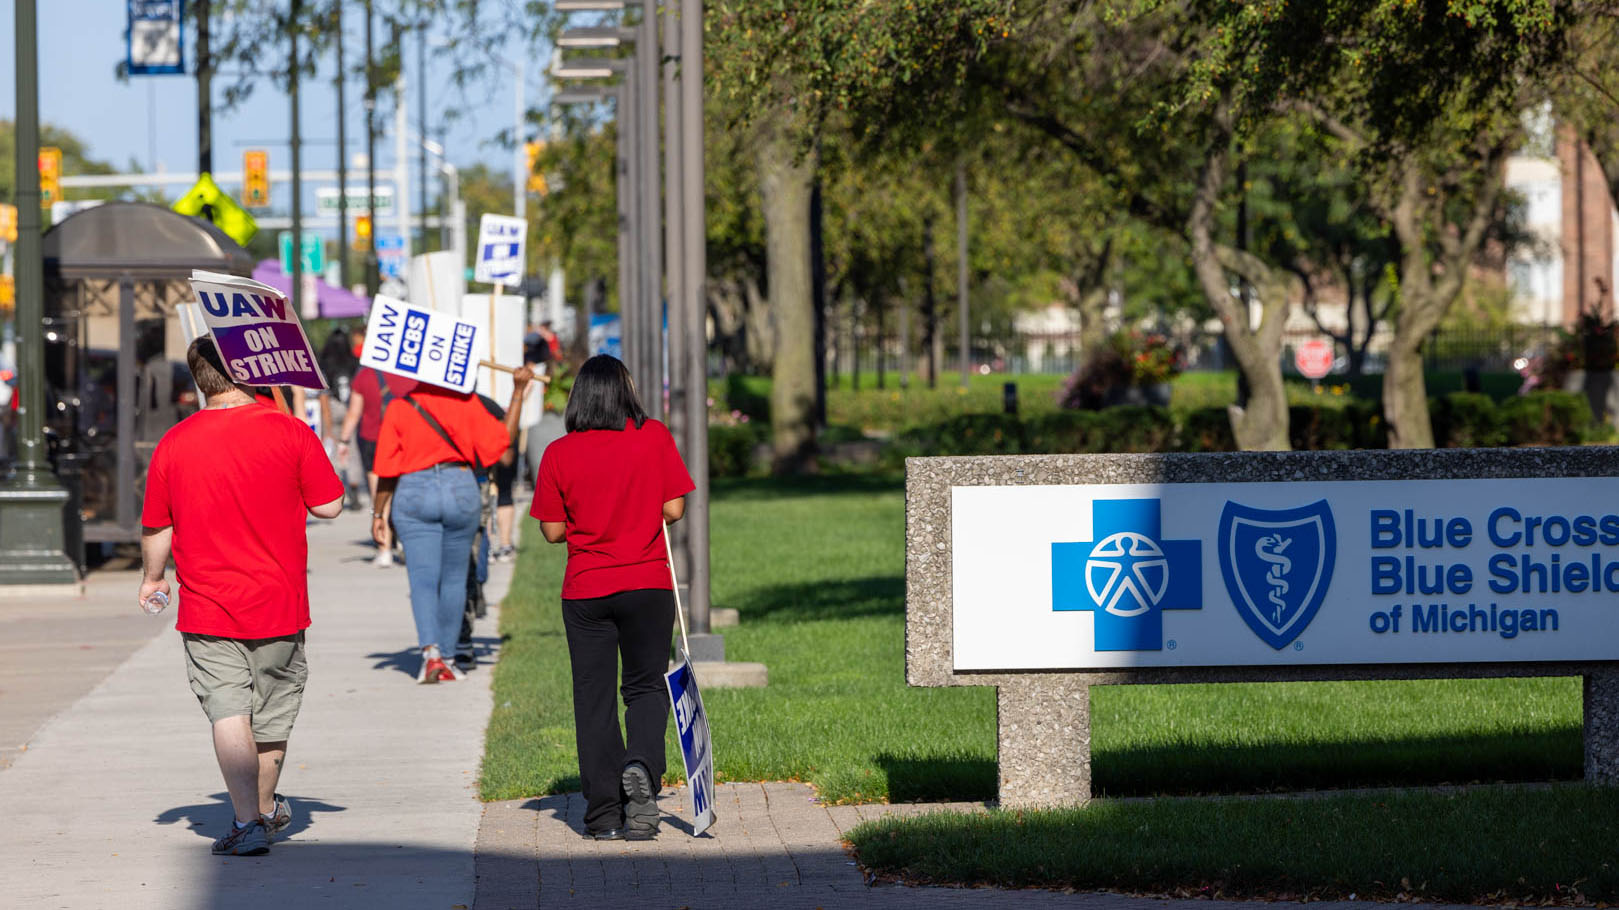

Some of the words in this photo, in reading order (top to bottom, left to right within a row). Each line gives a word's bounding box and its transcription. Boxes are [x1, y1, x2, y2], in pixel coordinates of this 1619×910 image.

[198, 290, 287, 320] UAW
[243, 326, 280, 352] ON
[372, 304, 399, 362] UAW
[399, 315, 426, 368] BCBS
[429, 335, 446, 361] ON
[230, 350, 312, 381] STRIKE
[446, 324, 473, 385] STRIKE
[1370, 509, 1473, 549] Blue
[1371, 556, 1473, 595] Blue
[1369, 604, 1402, 634] of
[1412, 603, 1559, 639] Michigan
